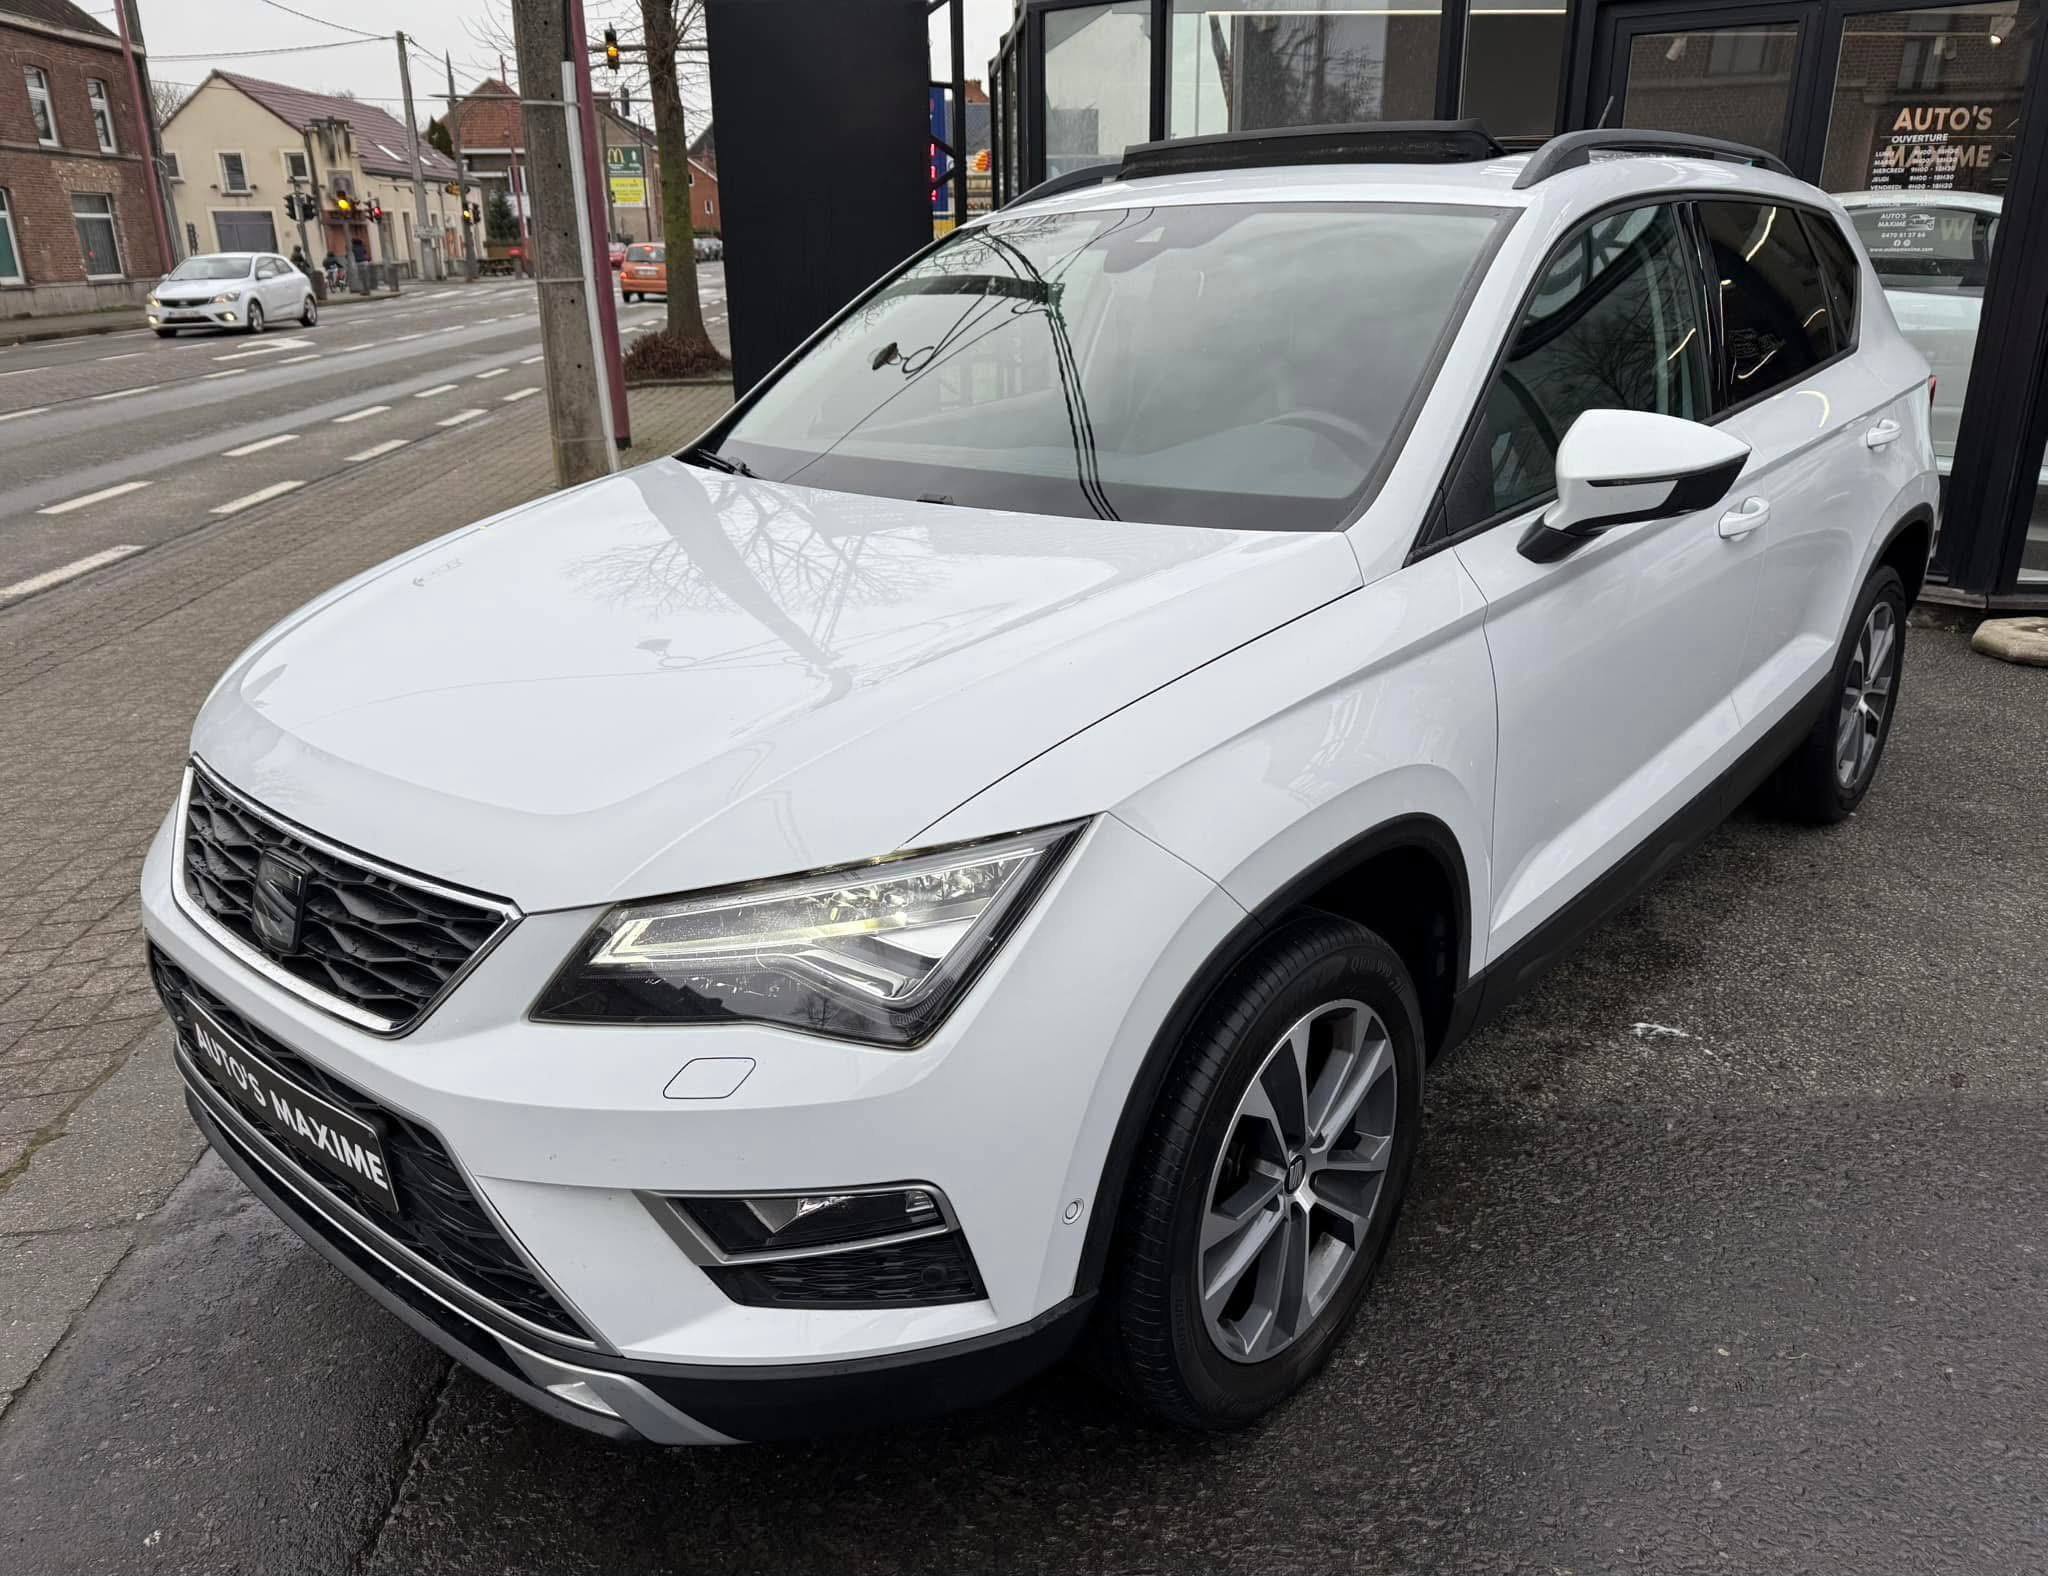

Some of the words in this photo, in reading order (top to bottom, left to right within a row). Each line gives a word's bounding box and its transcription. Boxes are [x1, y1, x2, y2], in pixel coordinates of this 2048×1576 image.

[1892, 105, 1993, 131] AUTO'S
[1891, 133, 1949, 144] OUVERTURE
[194, 1022, 267, 1107] AUTO'S
[270, 1089, 389, 1190] MAXIME
